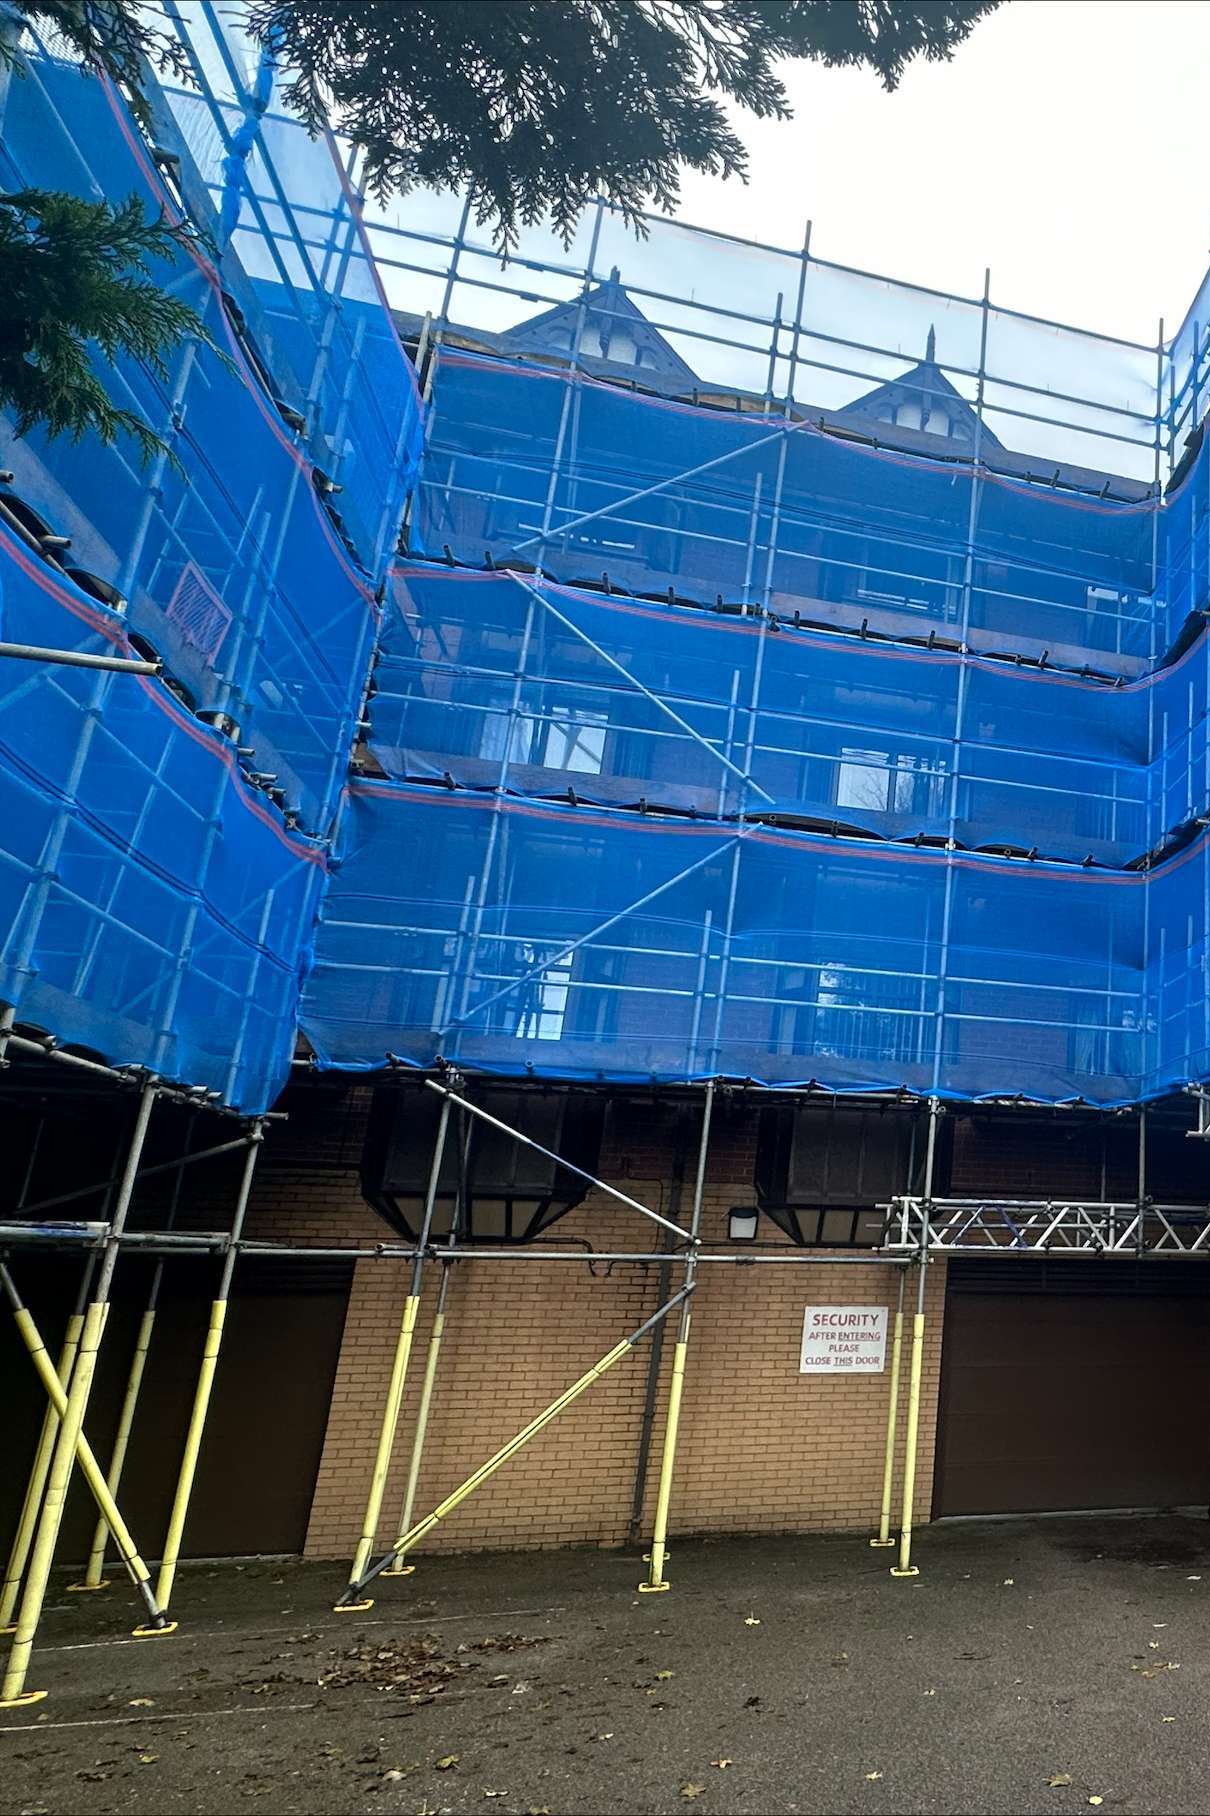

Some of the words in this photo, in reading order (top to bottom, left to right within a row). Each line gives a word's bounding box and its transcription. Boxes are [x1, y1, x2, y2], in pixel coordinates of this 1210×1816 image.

[813, 1314, 879, 1326] SECURITY
[808, 1331, 837, 1341] AFTER
[838, 1331, 881, 1342] ENTERING
[829, 1344, 860, 1353] PLEASE
[805, 1356, 832, 1366] CLOSE
[834, 1356, 854, 1366] THIS
[855, 1356, 880, 1365] DOOR
